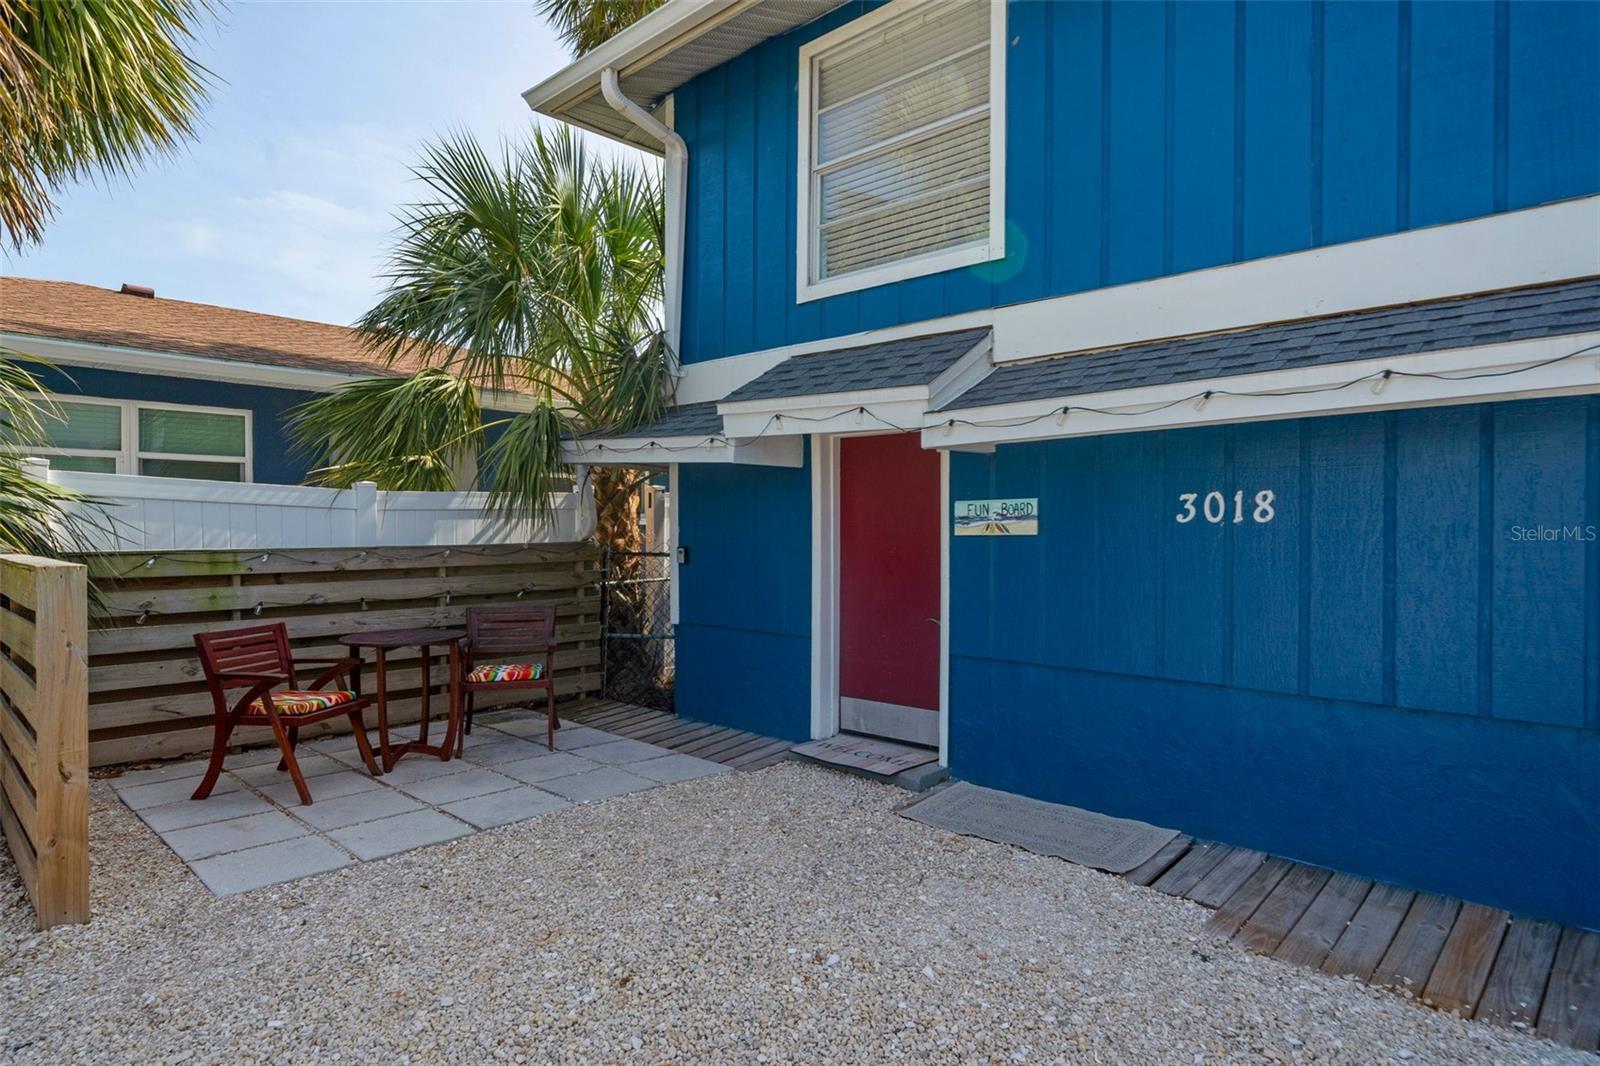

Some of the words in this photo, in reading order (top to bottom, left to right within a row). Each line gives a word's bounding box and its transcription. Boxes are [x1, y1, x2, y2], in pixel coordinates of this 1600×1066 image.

[967, 503, 990, 516] FUN
[1001, 502, 1034, 516] BOARD
[1176, 489, 1275, 523] 3018
